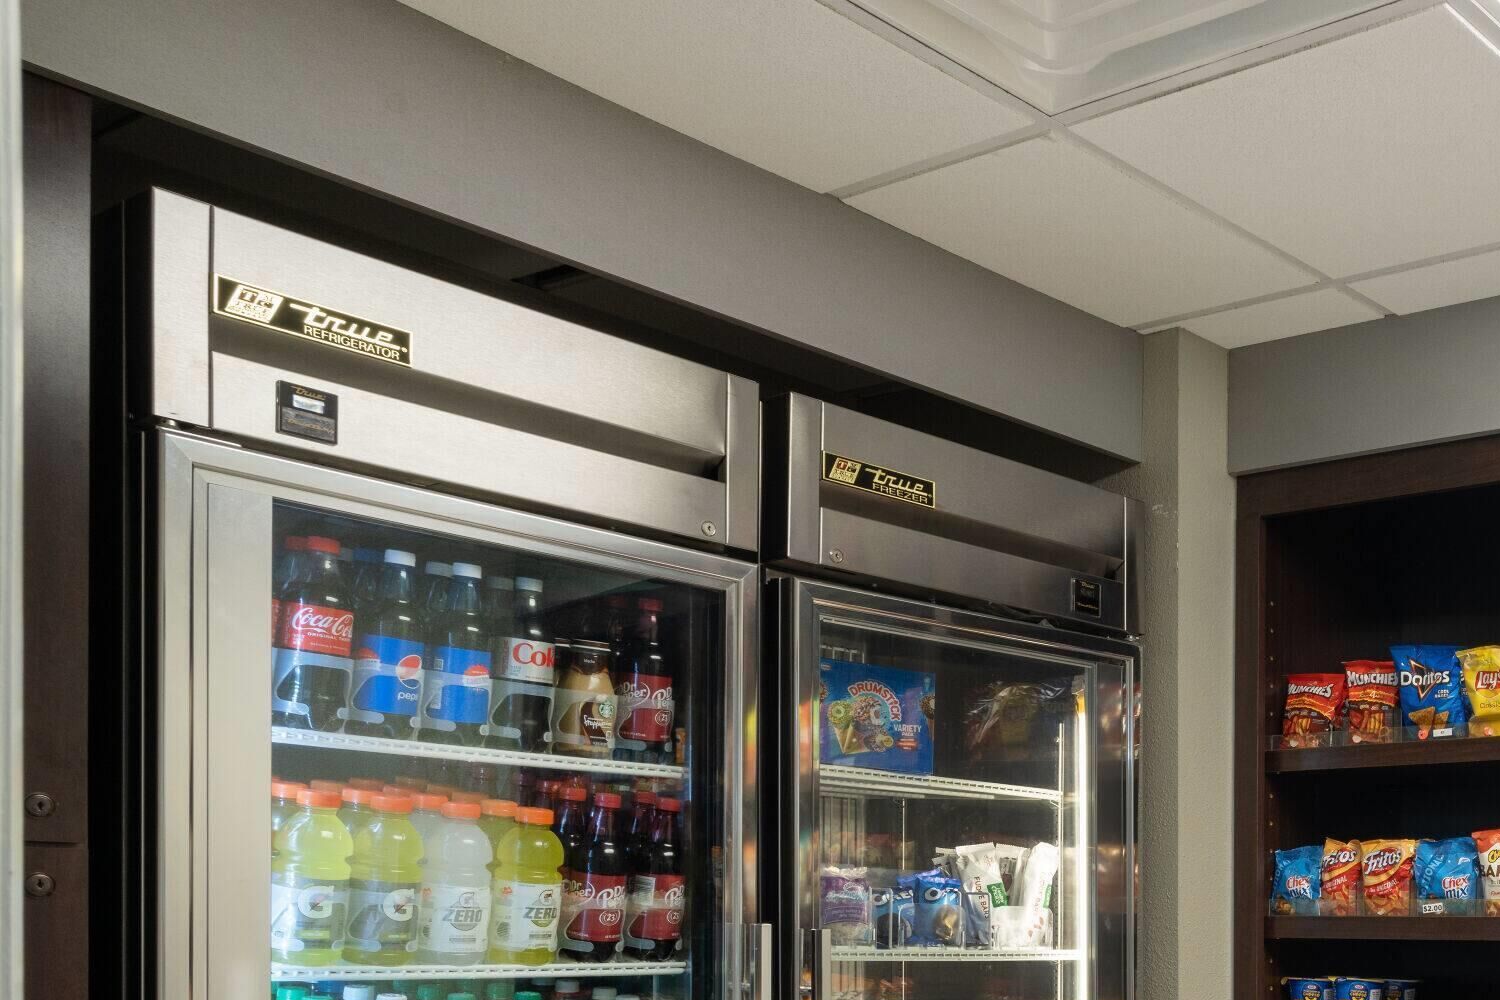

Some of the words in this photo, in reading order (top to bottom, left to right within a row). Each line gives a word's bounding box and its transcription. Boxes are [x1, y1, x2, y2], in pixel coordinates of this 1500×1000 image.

[290, 303, 400, 350] true
[304, 325, 400, 360] REFRIGERATOR
[865, 467, 928, 496] true
[872, 482, 928, 504] FREEZER
[1347, 670, 1398, 687] MUNCHIES
[1400, 670, 1450, 686] Doritos
[1288, 682, 1333, 697] MUNCHIES
[848, 680, 901, 722] DRUMSTICK
[893, 723, 922, 736] VARIETY
[1364, 851, 1401, 874] Fritos
[1442, 874, 1469, 889] Chex
[1445, 888, 1468, 899] mix
[443, 910, 482, 922] ZERO
